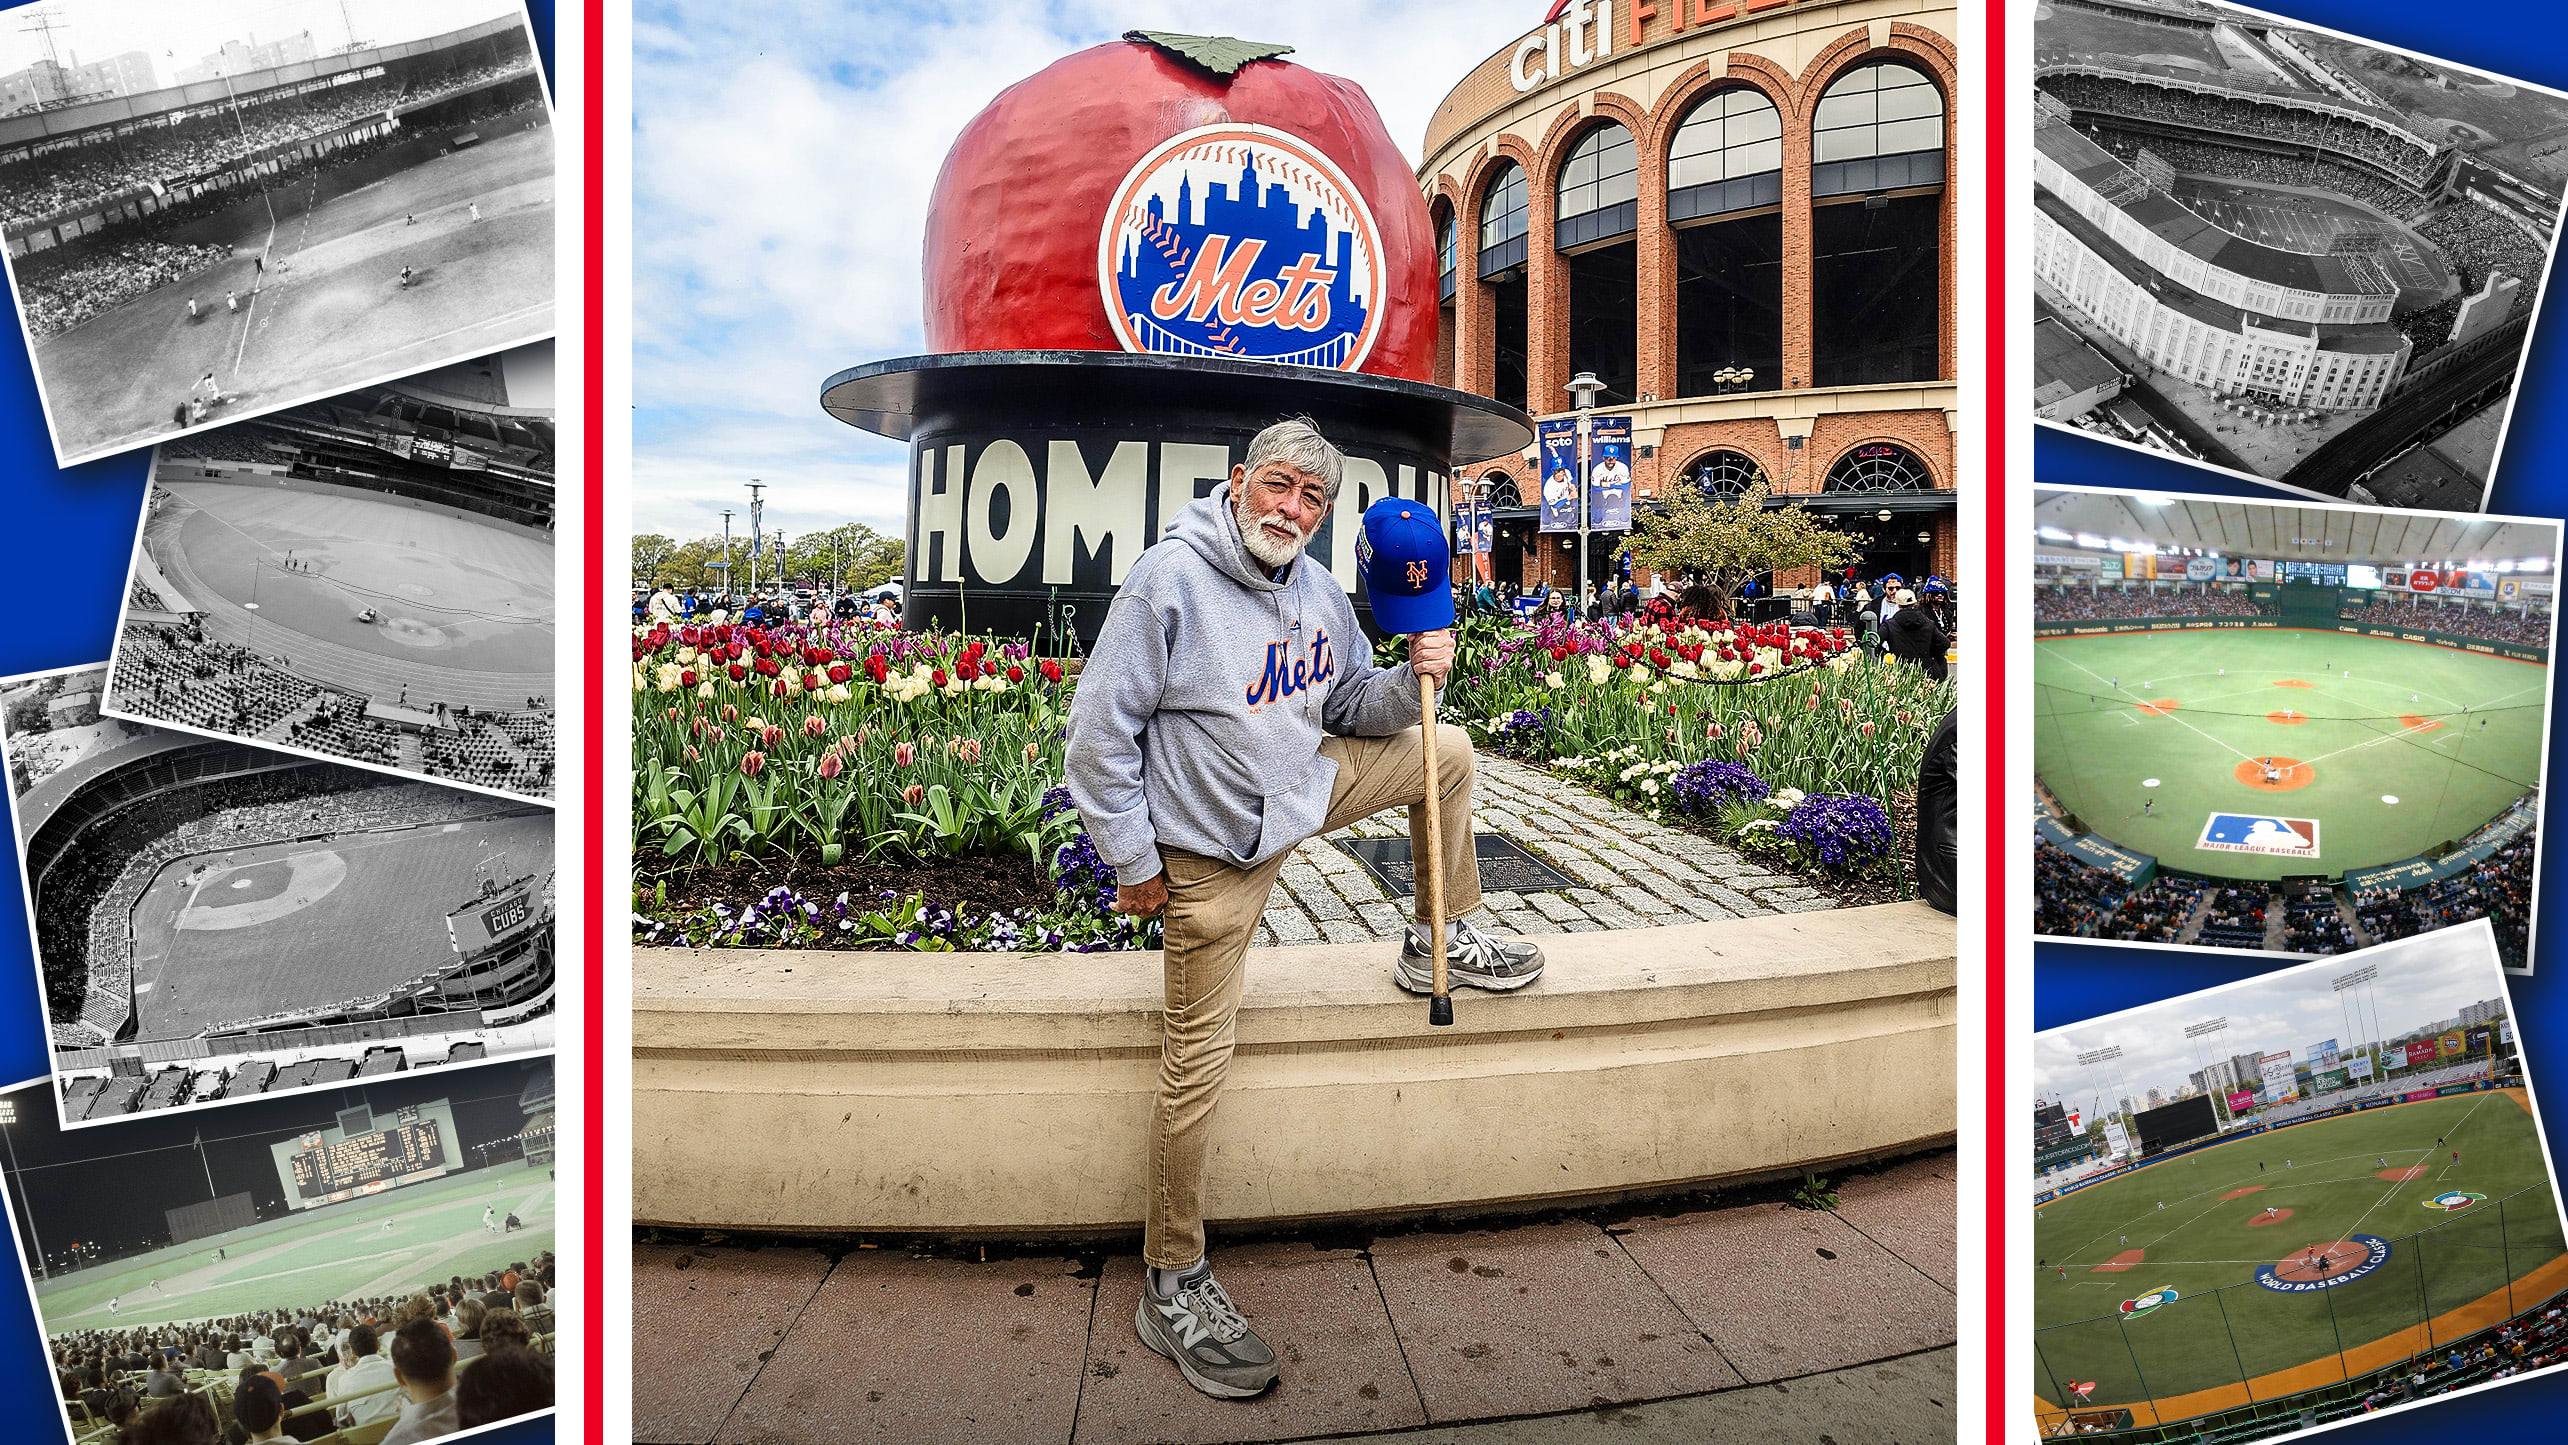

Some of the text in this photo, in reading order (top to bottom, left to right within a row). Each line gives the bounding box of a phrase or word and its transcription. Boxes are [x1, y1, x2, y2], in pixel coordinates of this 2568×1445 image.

[1510, 0, 1612, 92] citi
[1151, 233, 1339, 332] Mets
[1545, 437, 1573, 448] soto
[1592, 435, 1631, 444] williams
[916, 438, 1231, 586] HOME
[2402, 633, 2426, 642] CASIO
[1246, 628, 1335, 706] Mets
[2202, 842, 2314, 857] MAJOR LEAGUE BASEBALL
[490, 897, 522, 917] CHICAGO
[492, 904, 525, 932] CUBS
[2408, 1047, 2433, 1057] RAMADA
[2366, 1098, 2389, 1108] KONAMI
[2276, 1119, 2292, 1127] WORLD
[2259, 1238, 2387, 1291] WORLD BASEBALL CLASSIC
